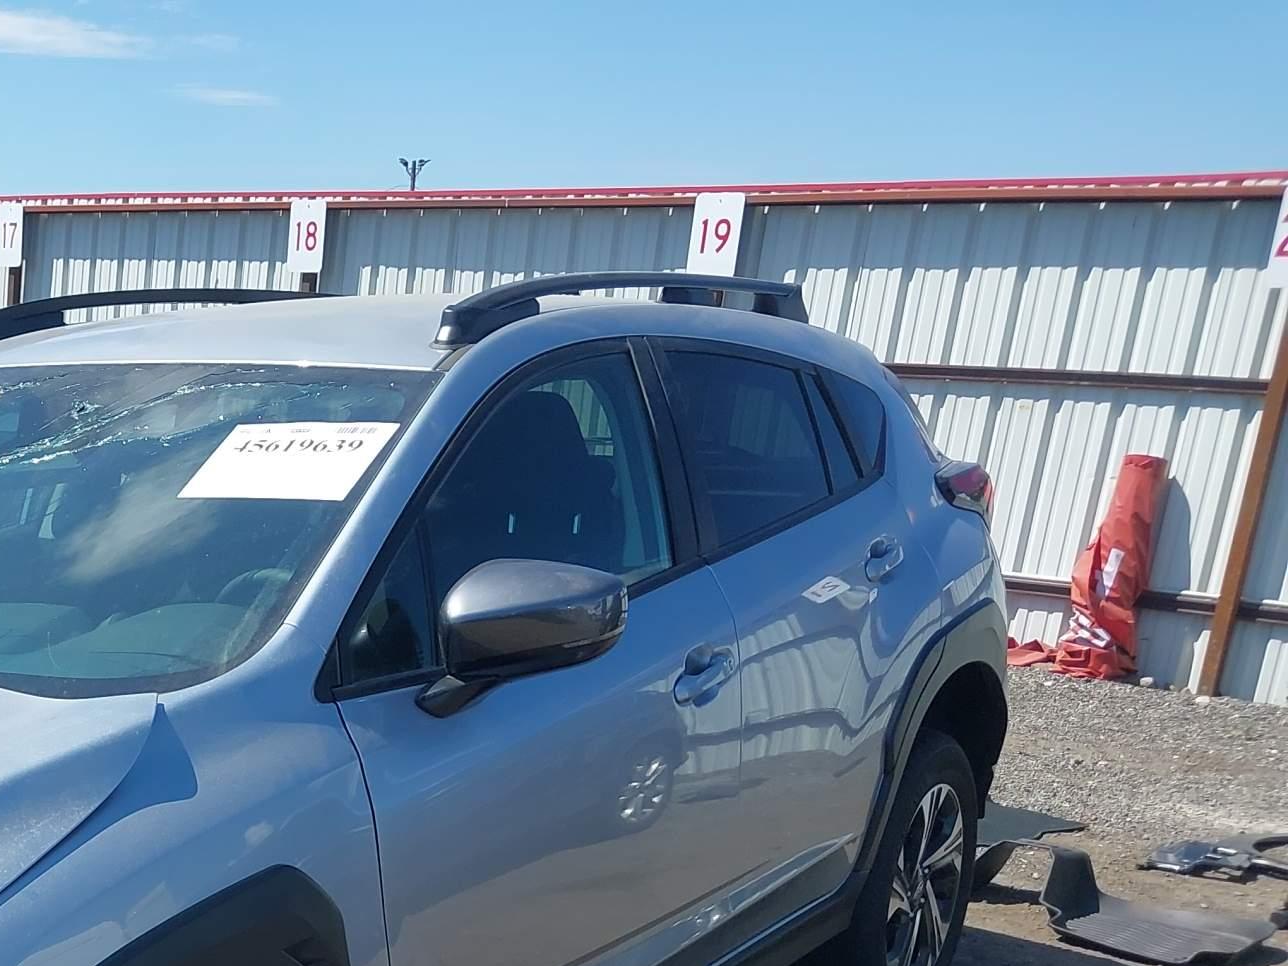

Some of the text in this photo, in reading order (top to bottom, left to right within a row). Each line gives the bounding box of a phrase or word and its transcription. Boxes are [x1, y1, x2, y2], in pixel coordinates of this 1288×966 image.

[3, 222, 18, 249] 17
[295, 221, 318, 251] 18
[699, 218, 732, 254] 19
[233, 438, 365, 453] 45619639
